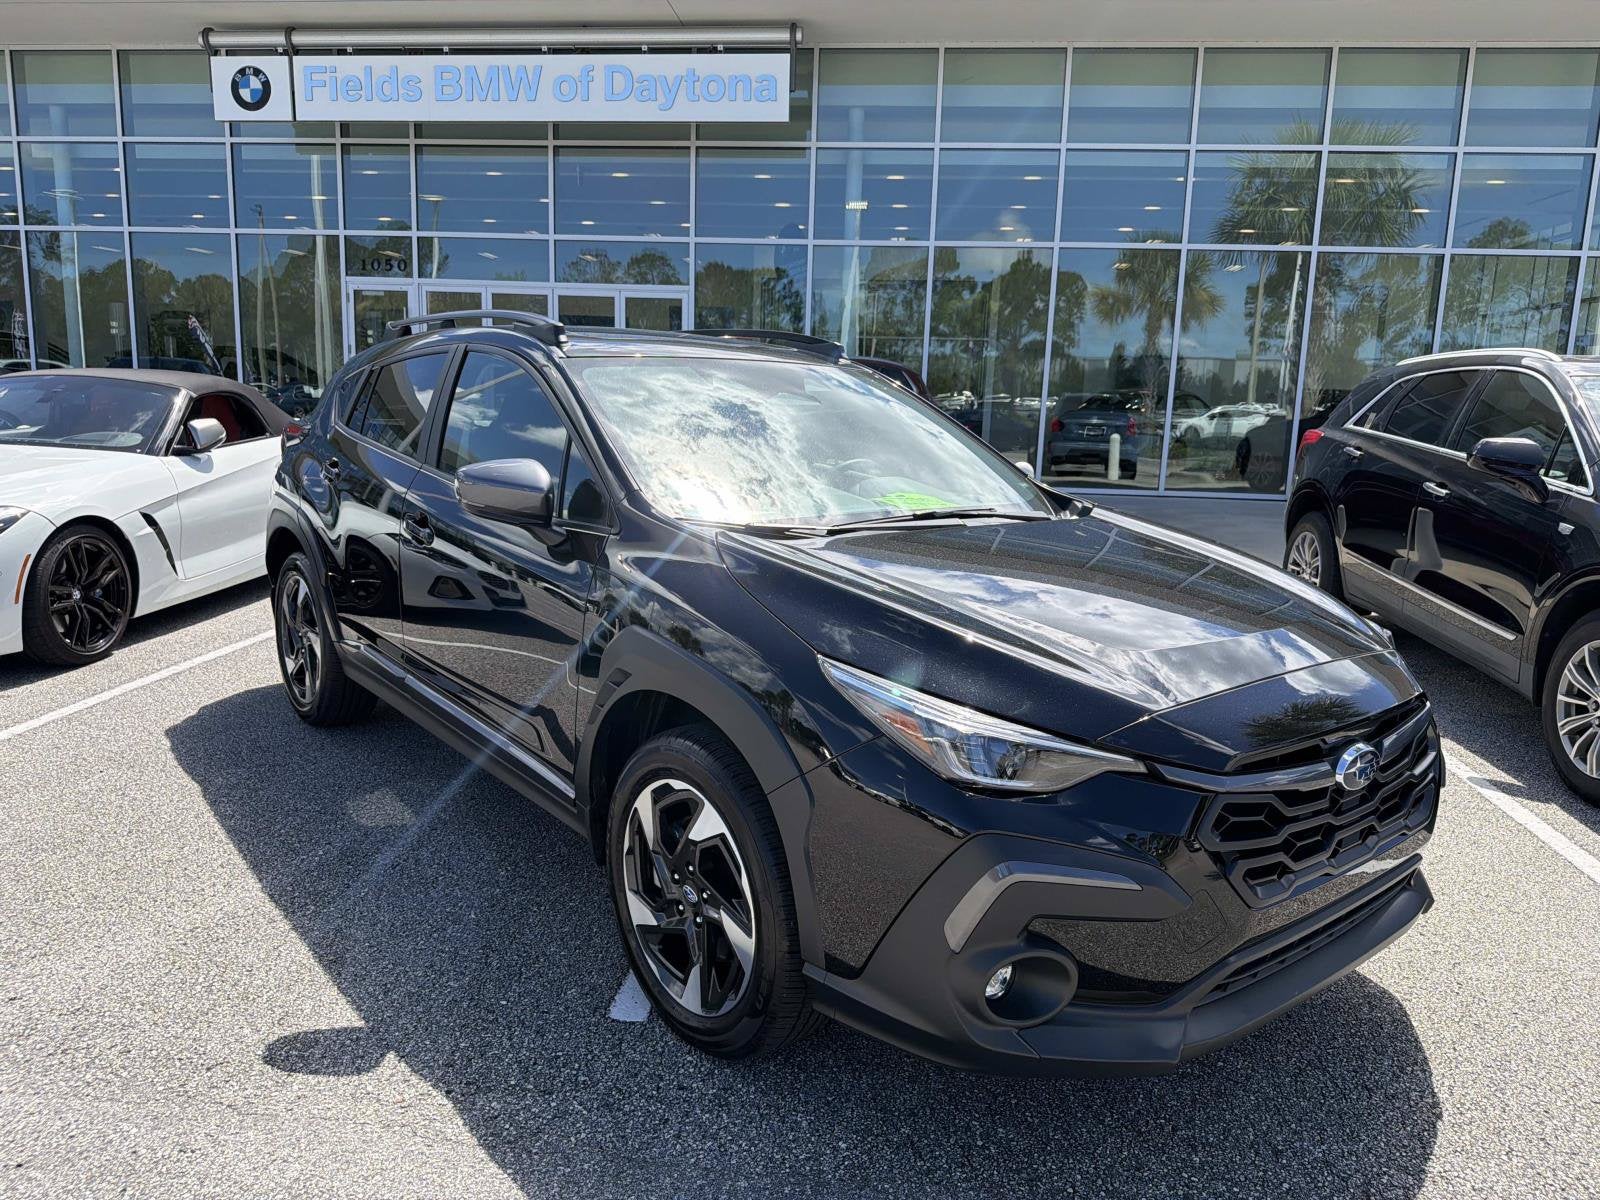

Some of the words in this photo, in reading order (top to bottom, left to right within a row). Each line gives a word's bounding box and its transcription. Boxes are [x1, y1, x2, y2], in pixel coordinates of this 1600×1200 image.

[234, 67, 267, 82] BMW
[303, 64, 423, 102] Fields
[433, 64, 543, 102] BMW
[552, 64, 595, 102] of
[603, 64, 778, 112] Daytona
[361, 258, 407, 272] 1050
